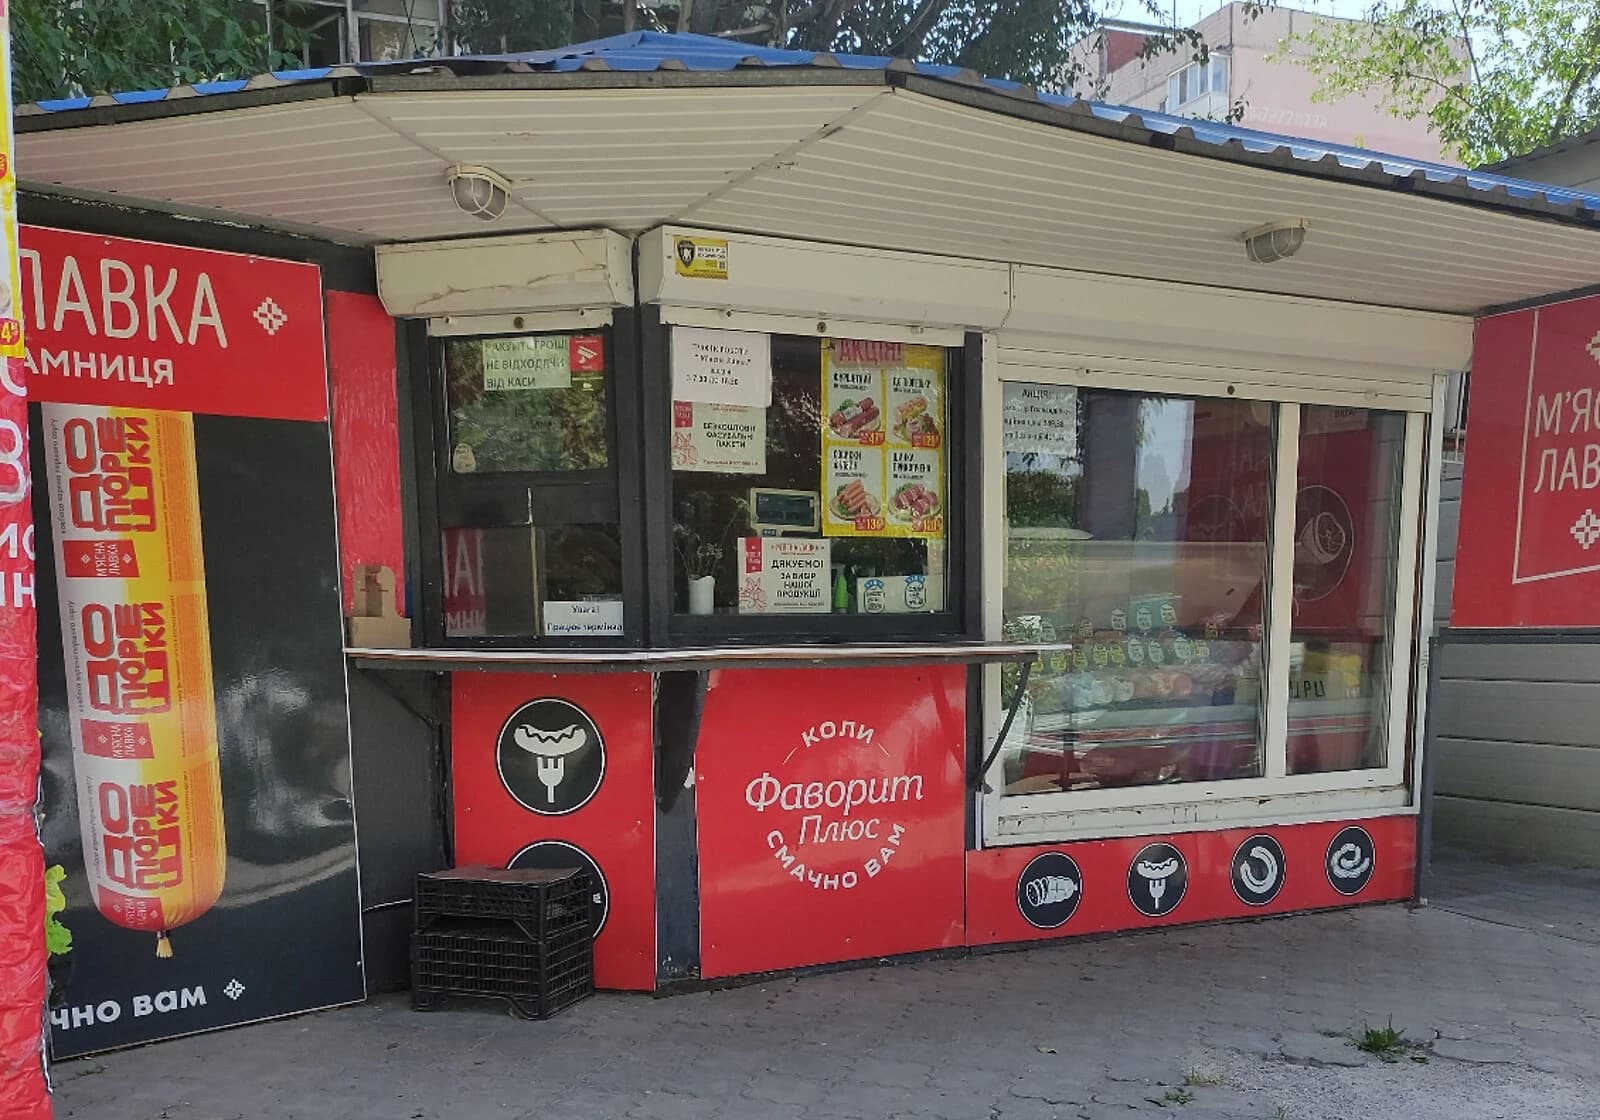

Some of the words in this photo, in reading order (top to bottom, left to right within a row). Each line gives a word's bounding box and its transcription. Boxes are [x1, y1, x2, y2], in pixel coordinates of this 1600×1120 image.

[486, 360, 500, 370] НЕ
[487, 378, 505, 390] ВІД
[508, 376, 536, 387] КАСИ
[64, 417, 106, 532] ДО
[81, 603, 122, 715] ДО
[801, 719, 874, 748] КОЛИ
[745, 772, 924, 816] Фаворит
[99, 782, 137, 889] ДО
[798, 814, 880, 845] Плюс
[766, 830, 858, 890] СМАЧНО
[864, 823, 906, 878] ВАМ
